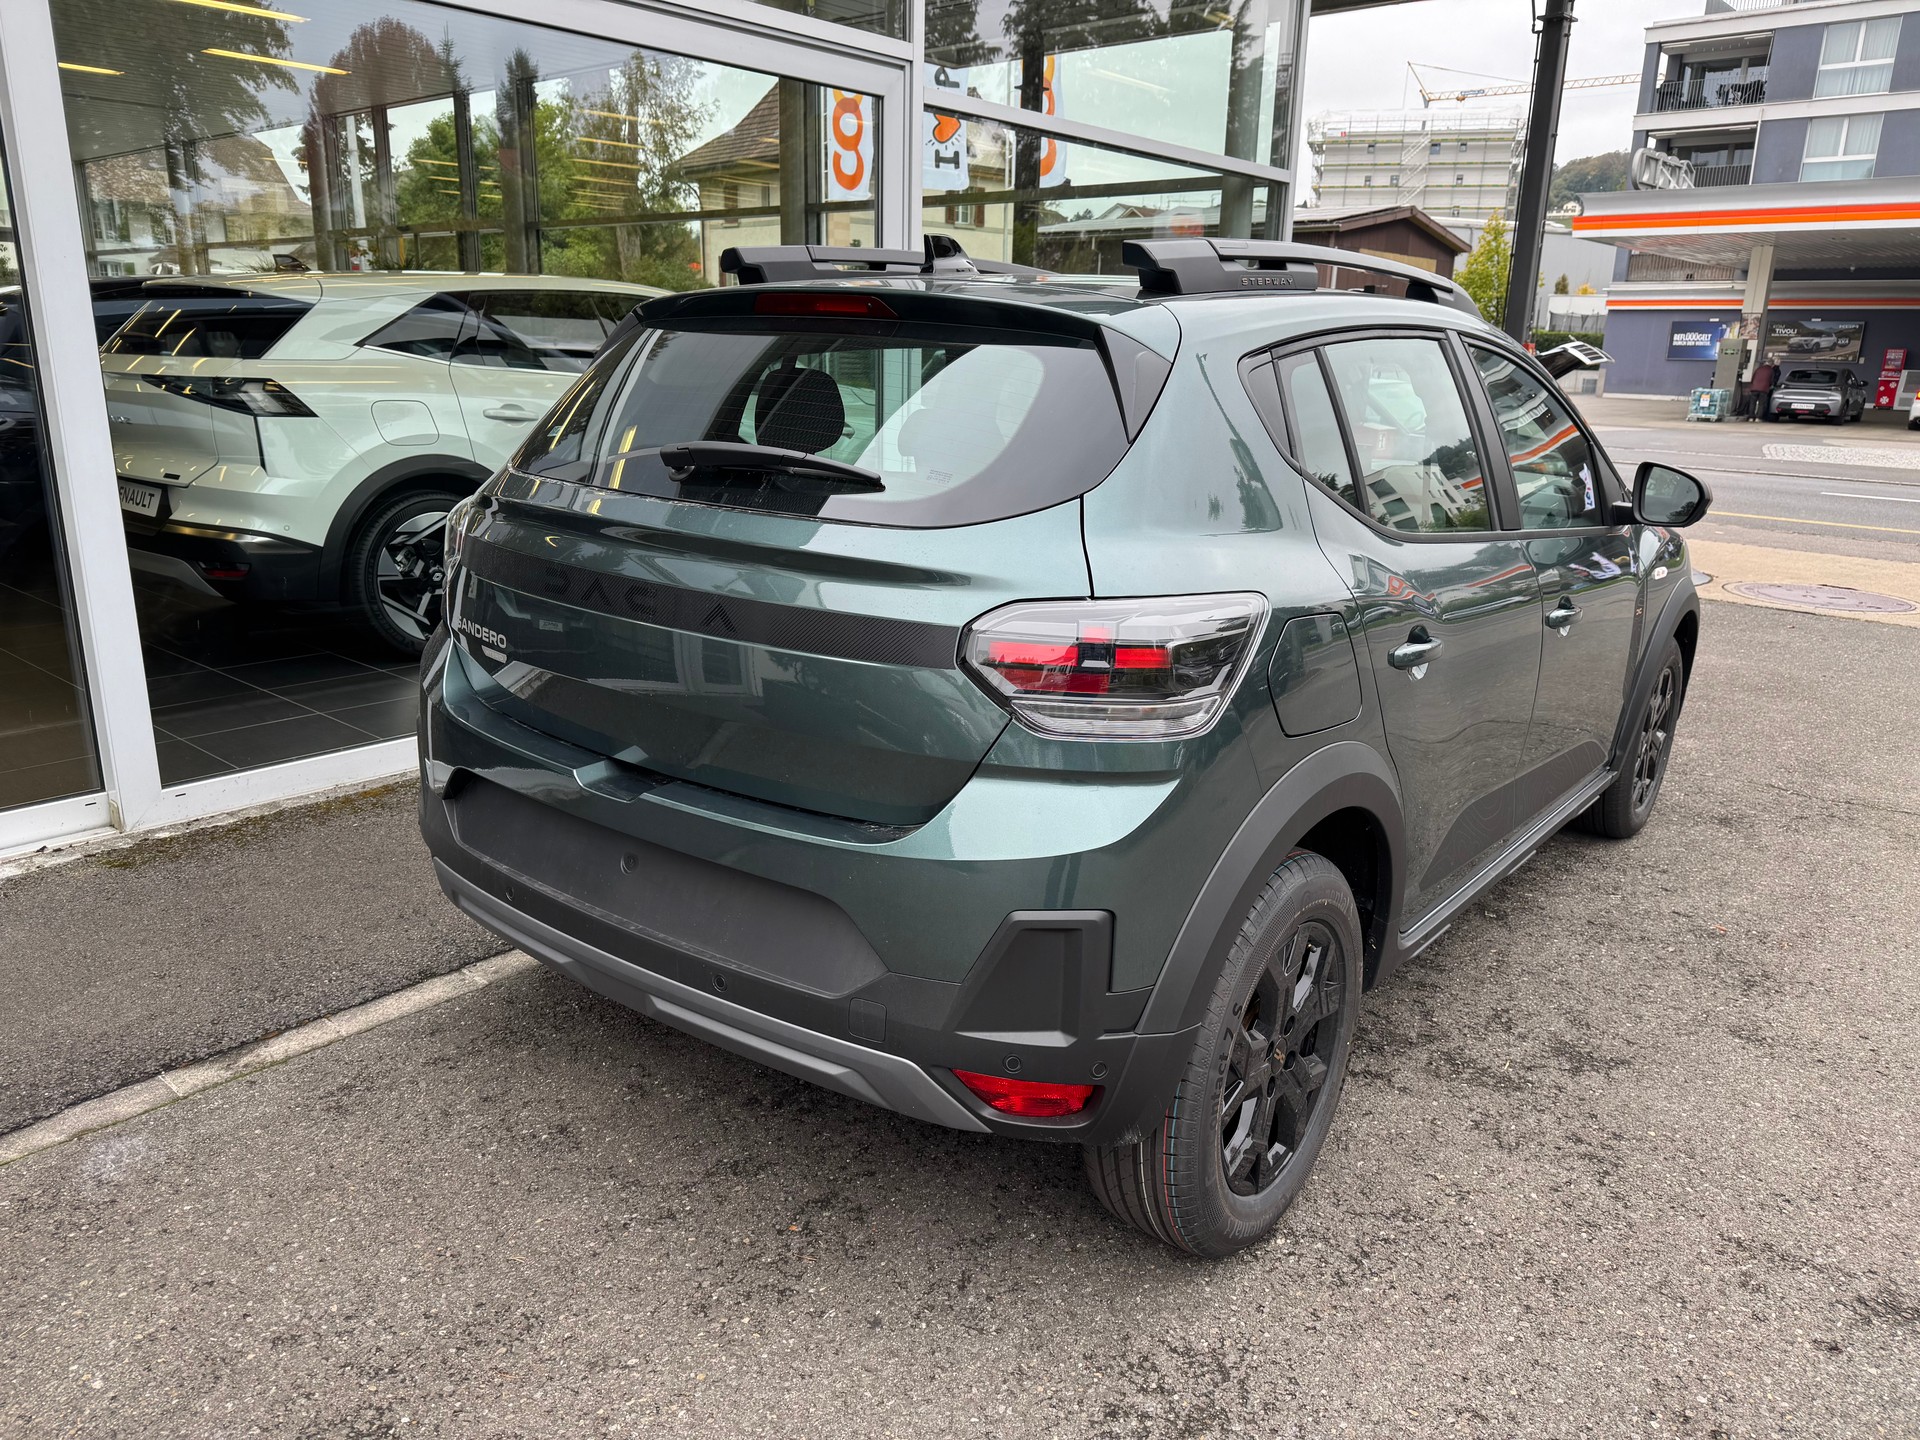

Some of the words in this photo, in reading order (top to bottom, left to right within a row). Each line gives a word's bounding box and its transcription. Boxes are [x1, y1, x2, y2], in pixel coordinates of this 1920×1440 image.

[1241, 277, 1293, 286] STEPWAY
[542, 566, 738, 635] DACA
[457, 615, 508, 649] SANDERO
